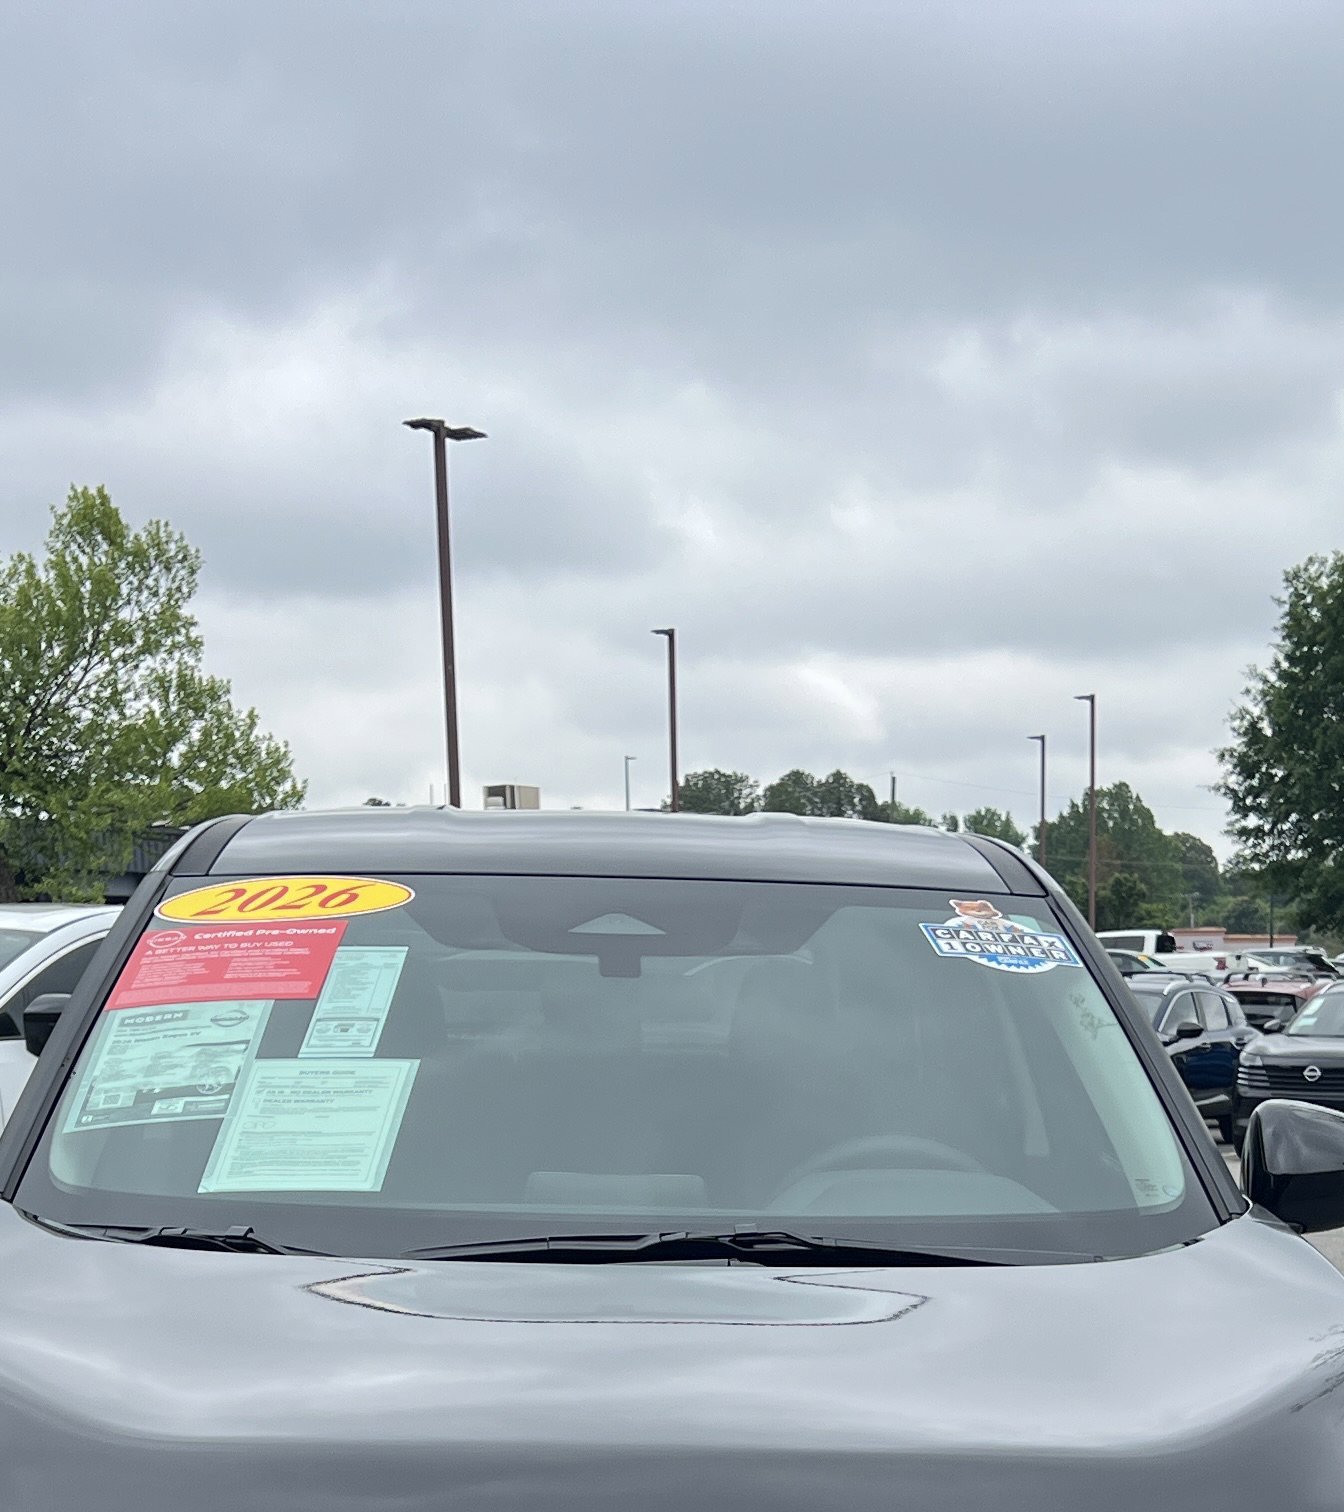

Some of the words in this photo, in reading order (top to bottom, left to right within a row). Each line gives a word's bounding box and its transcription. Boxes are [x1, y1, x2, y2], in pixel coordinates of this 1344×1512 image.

[190, 884, 376, 918] 2026
[194, 930, 254, 940] Certified
[255, 927, 337, 936] Pre-Owned
[935, 929, 1060, 950] CARFAX
[155, 946, 197, 954] BETTER
[944, 941, 958, 951] 1
[965, 942, 1068, 960] OWNER
[124, 1012, 184, 1025] MODERN
